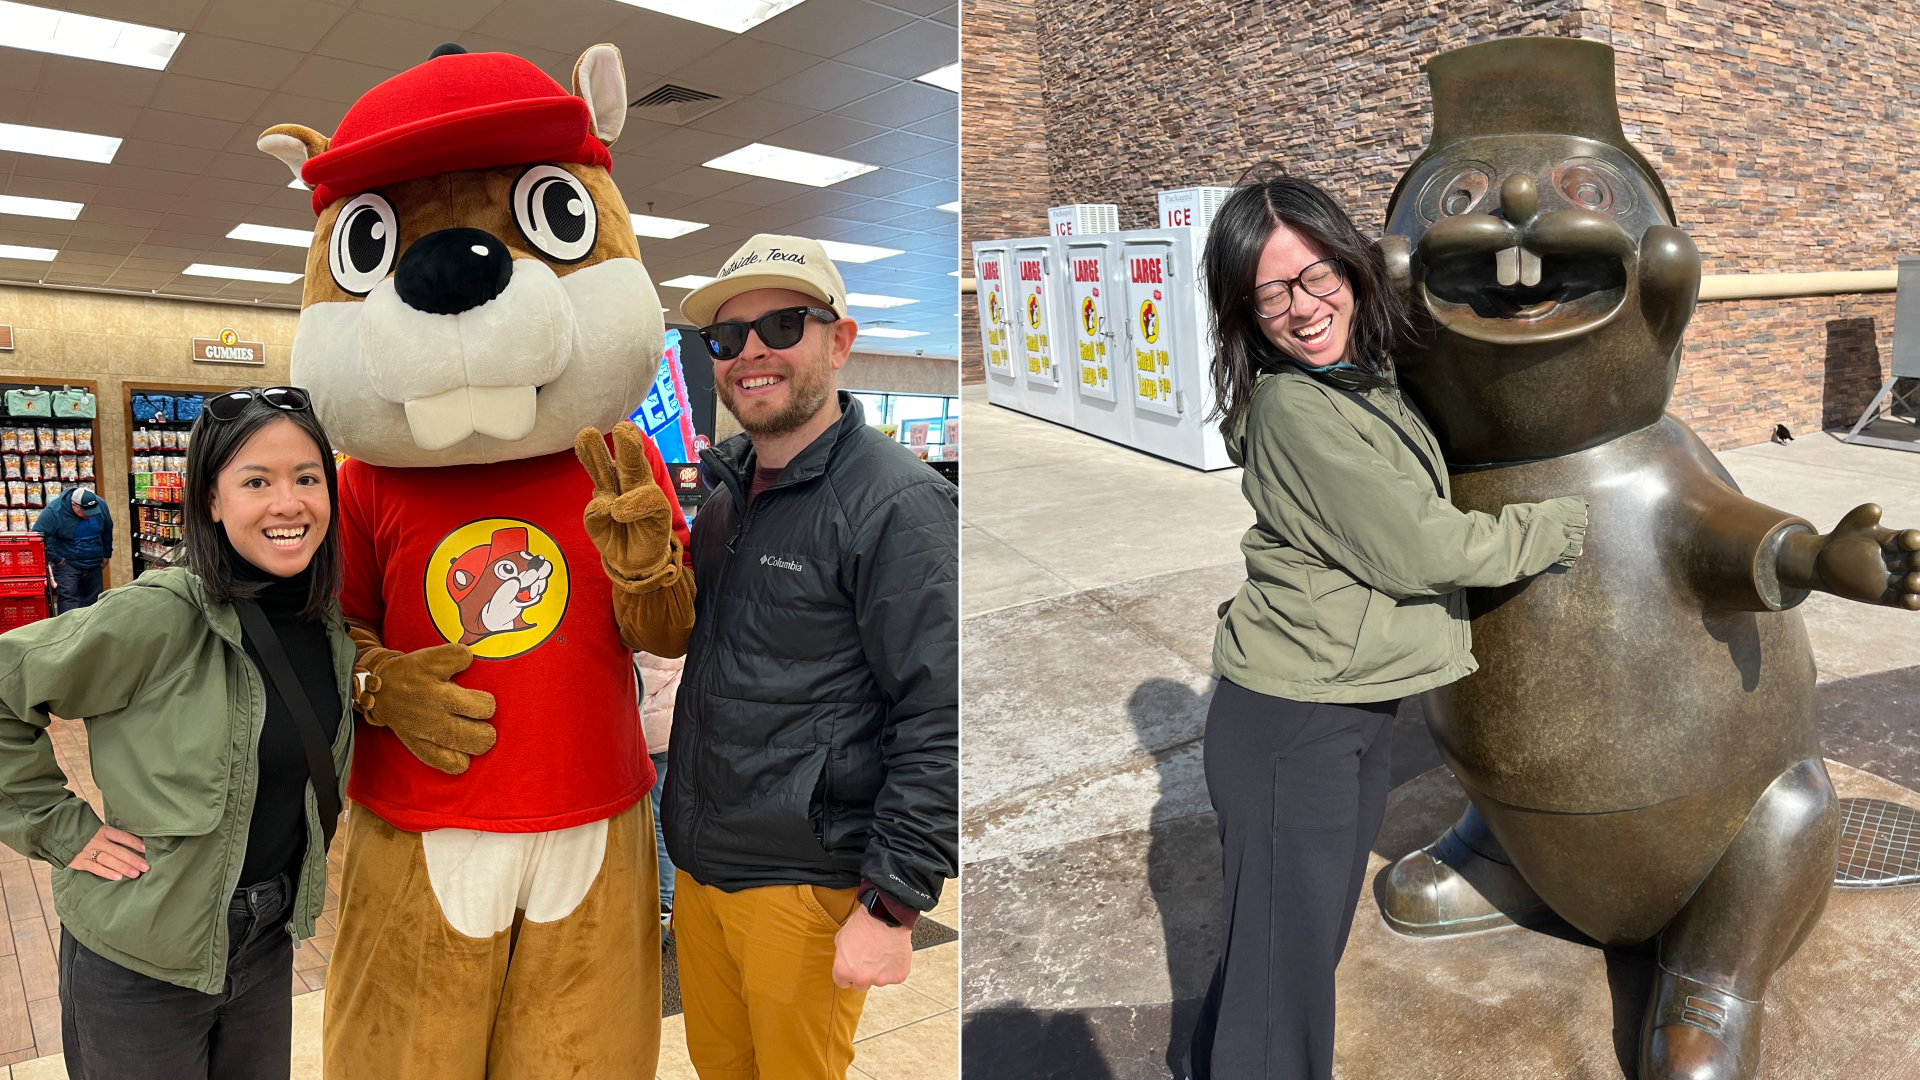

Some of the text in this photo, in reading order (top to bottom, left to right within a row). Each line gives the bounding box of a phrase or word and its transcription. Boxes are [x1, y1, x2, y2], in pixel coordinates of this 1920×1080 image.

[1056, 221, 1073, 237] ICE
[1168, 208, 1192, 228] ICE
[766, 248, 806, 265] Texas
[981, 261, 1000, 281] LARGE
[1019, 260, 1042, 282] LARGE
[1073, 258, 1100, 283] LARGE
[1130, 257, 1163, 284] LARGE
[205, 345, 254, 361] GUMMIES
[1079, 339, 1096, 362] Small
[1135, 347, 1156, 373] Small
[1081, 362, 1098, 388] Large
[1137, 373, 1158, 401] Large
[766, 555, 803, 572] Columbia
